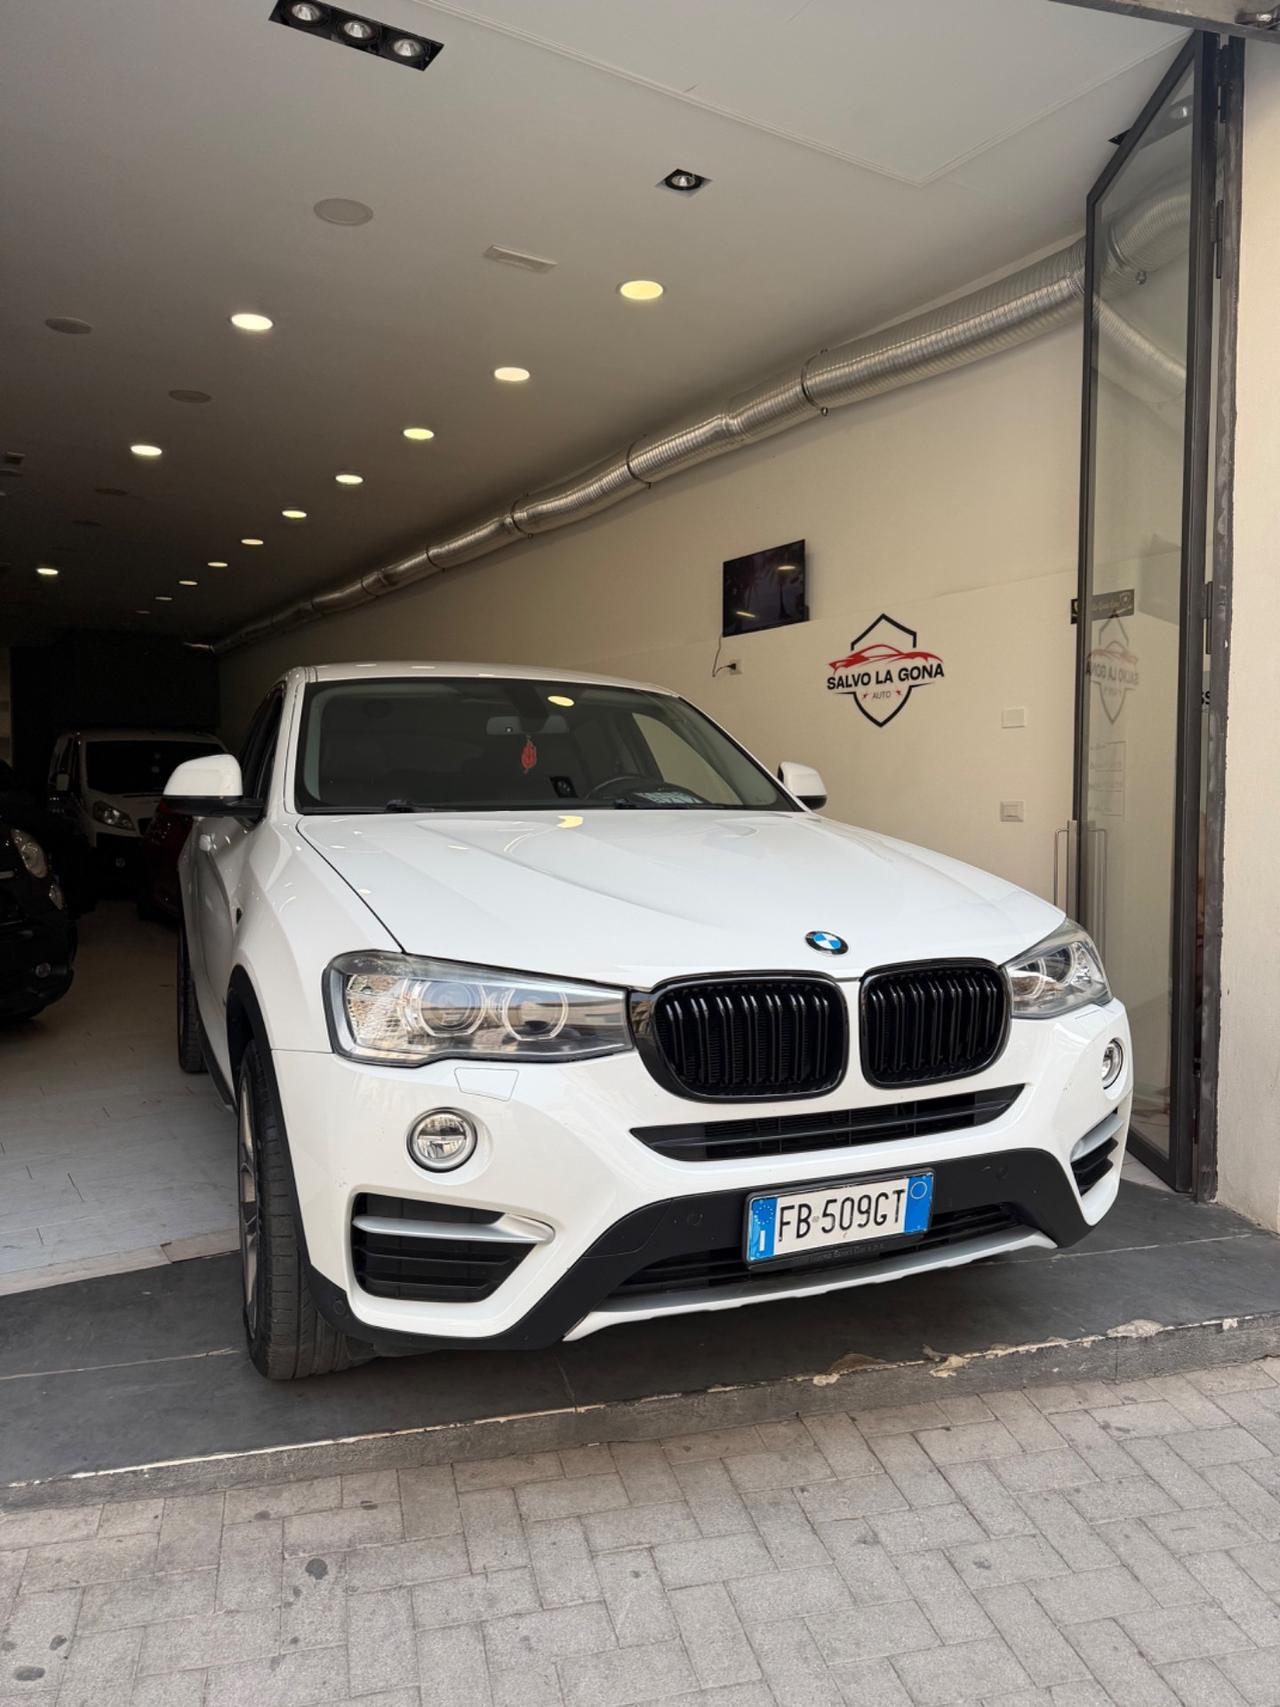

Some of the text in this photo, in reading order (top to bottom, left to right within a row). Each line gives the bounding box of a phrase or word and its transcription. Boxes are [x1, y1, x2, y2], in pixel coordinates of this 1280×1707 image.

[827, 663, 944, 690] SALVO LA GONA
[871, 691, 891, 700] AUTO
